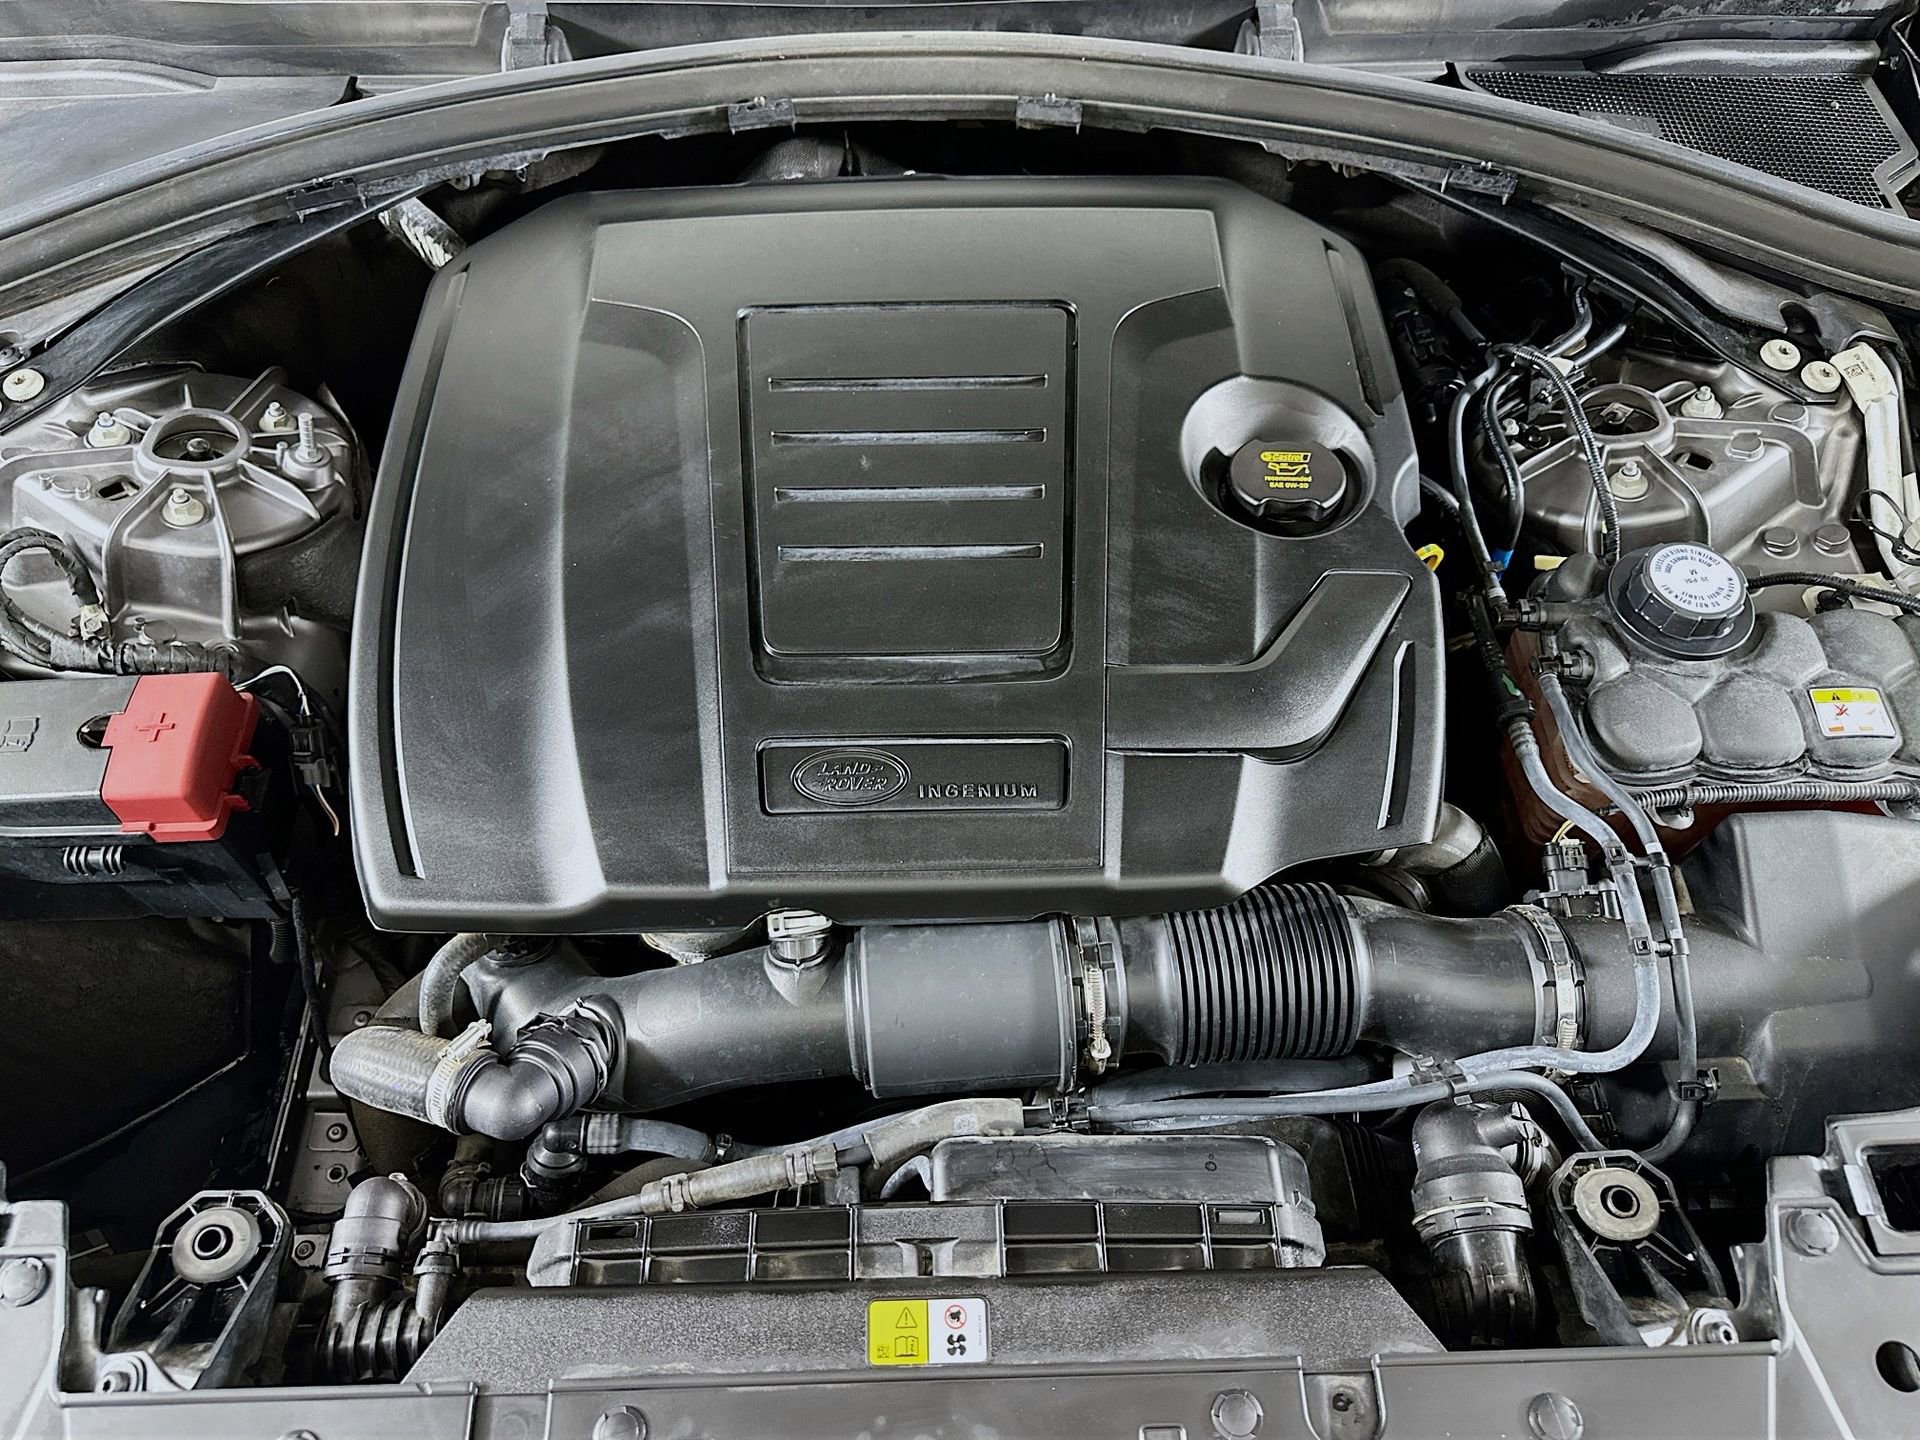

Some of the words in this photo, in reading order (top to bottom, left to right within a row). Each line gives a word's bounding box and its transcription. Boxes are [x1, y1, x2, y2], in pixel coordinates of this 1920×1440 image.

[1674, 594, 1692, 605] OPEN
[817, 761, 872, 776] LAND
[820, 776, 888, 792] ROVER
[919, 783, 1038, 798] INGENIUM
